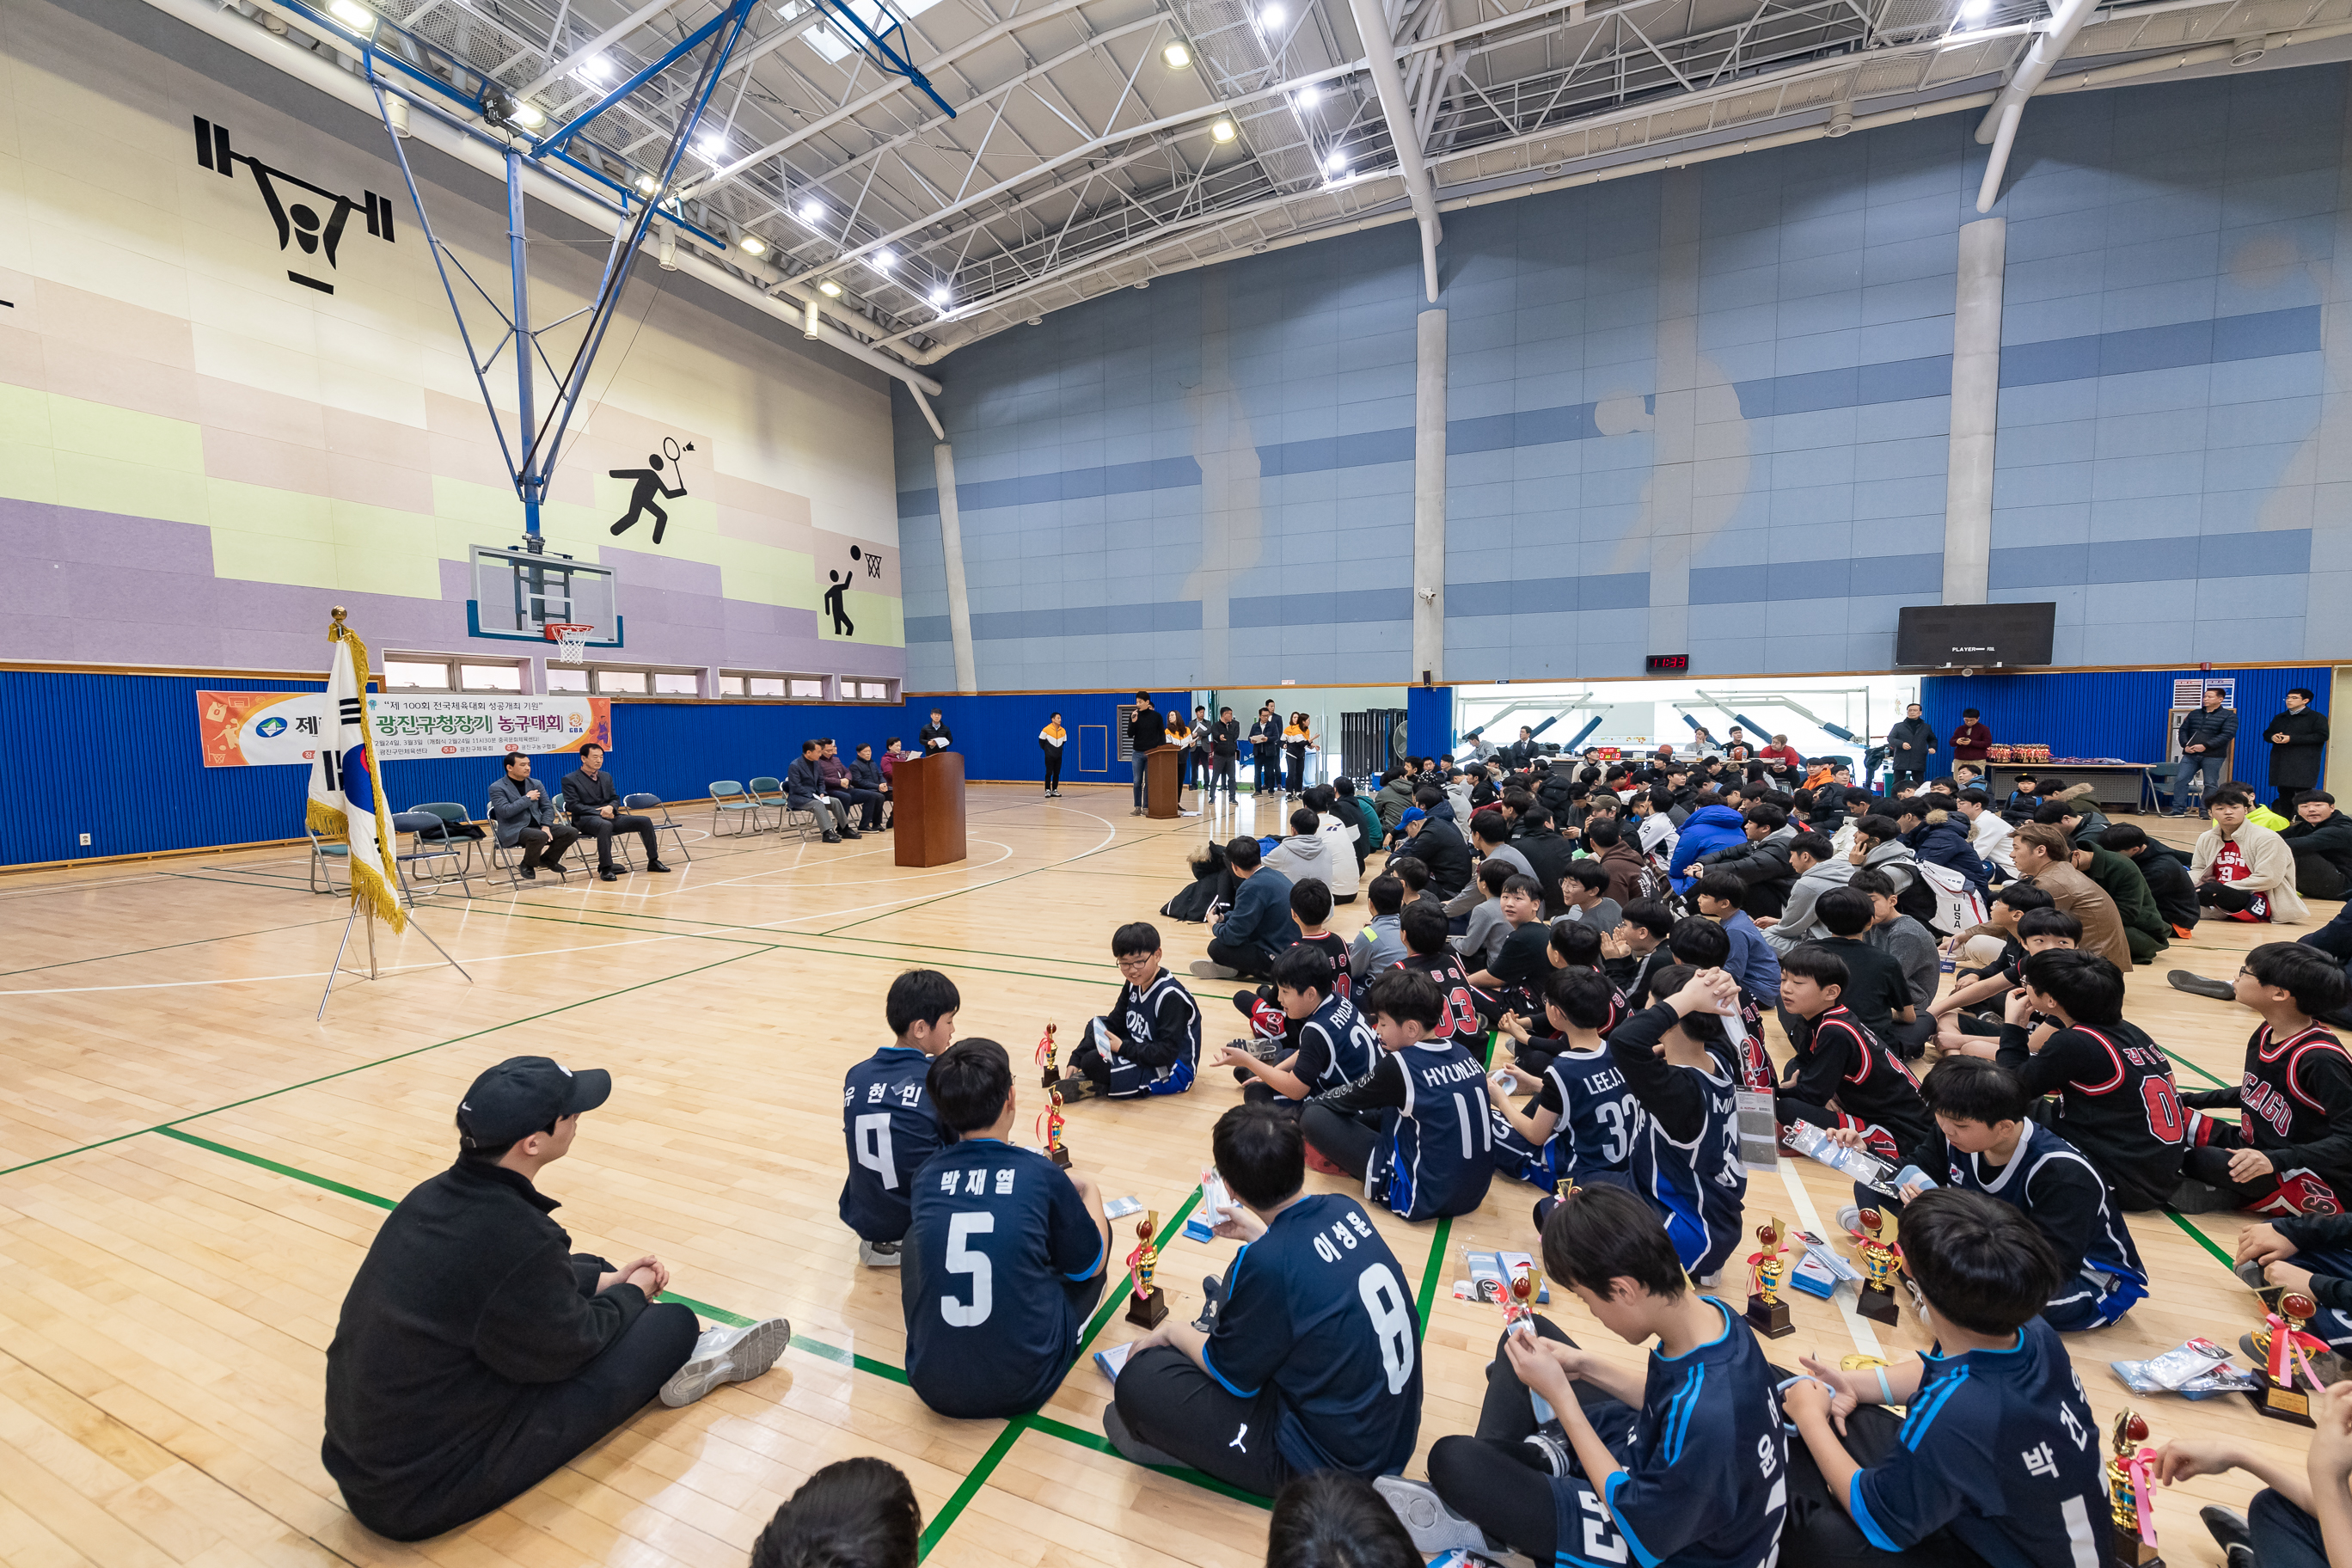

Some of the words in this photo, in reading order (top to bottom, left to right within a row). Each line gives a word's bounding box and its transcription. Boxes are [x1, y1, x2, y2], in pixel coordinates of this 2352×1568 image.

[1654, 657, 1686, 668] 11:33
[376, 714, 492, 736] 광진구청장기
[498, 714, 563, 732] 농구대회
[403, 701, 431, 710] 100회
[433, 701, 486, 711] 전국체육대회
[488, 701, 521, 711] 성공개최
[1953, 903, 1962, 929] USA
[1453, 1086, 1491, 1160] 11
[854, 1112, 899, 1191] 9
[940, 1210, 995, 1327] 5
[1357, 1262, 1415, 1395] 8
